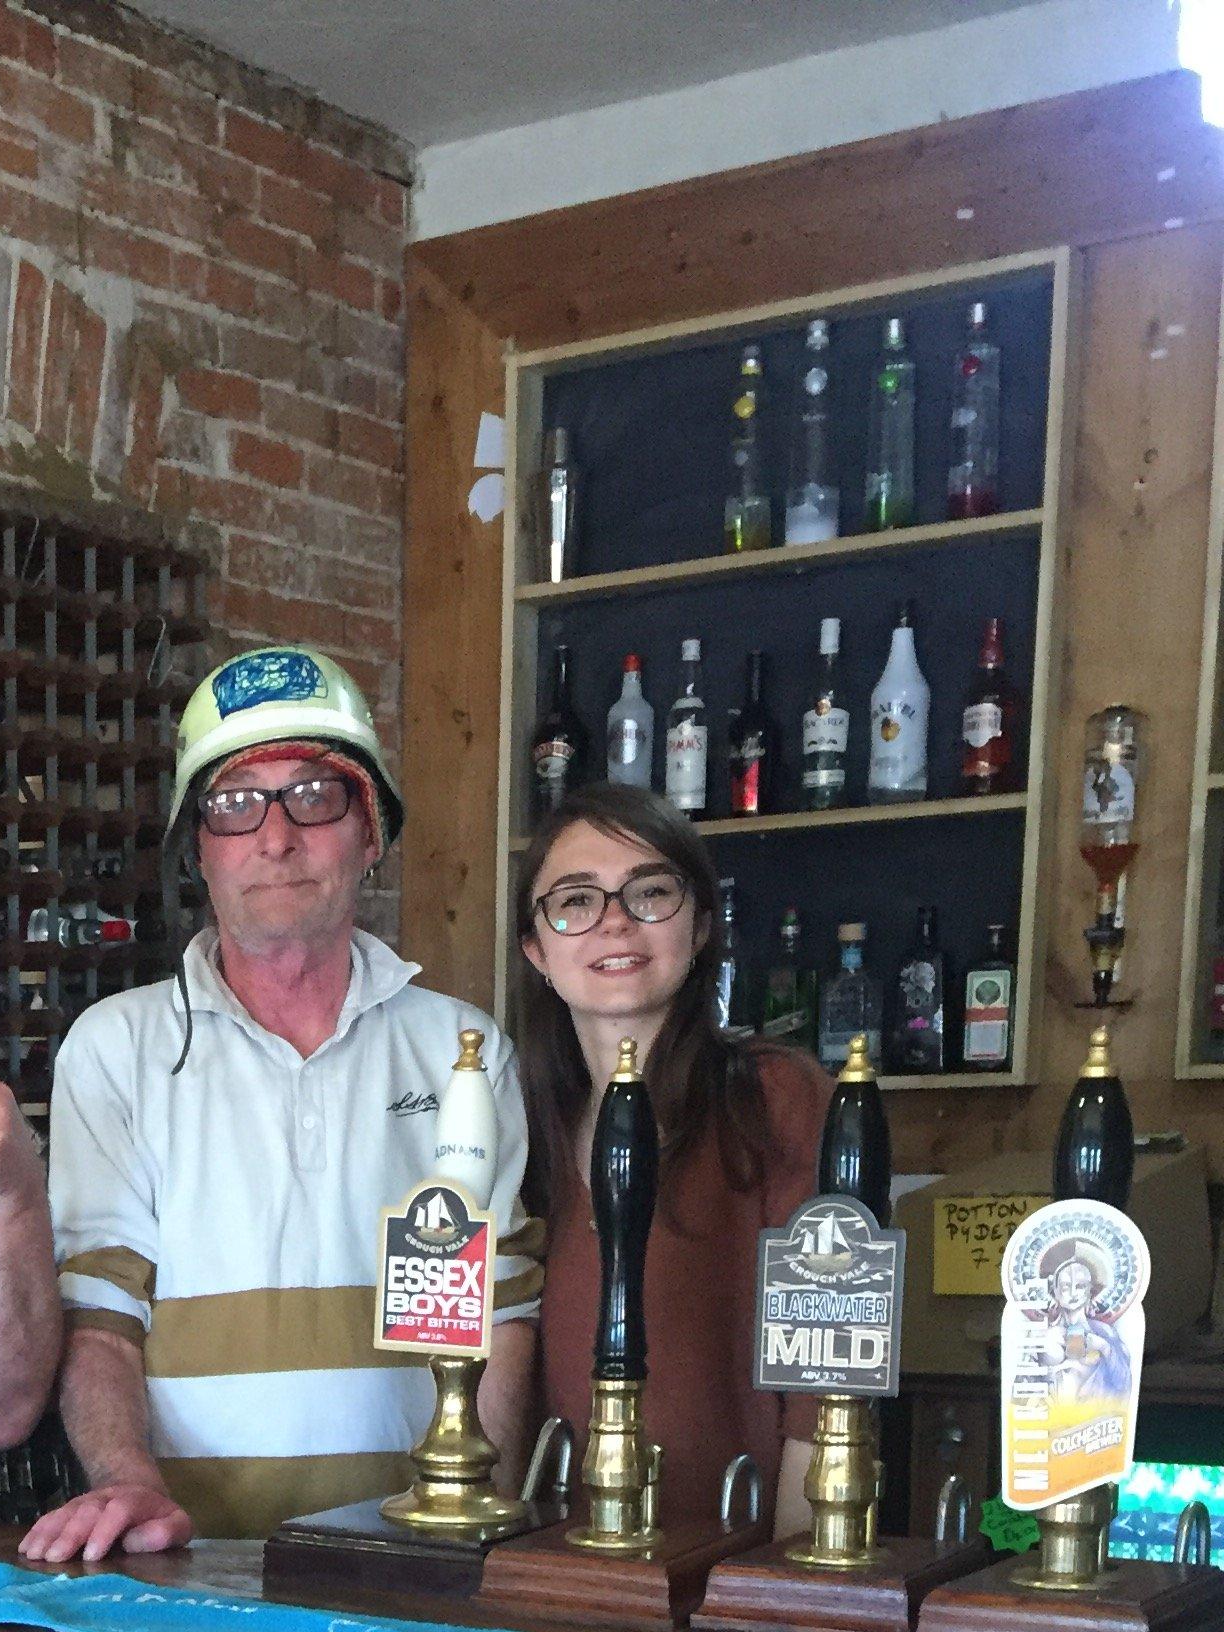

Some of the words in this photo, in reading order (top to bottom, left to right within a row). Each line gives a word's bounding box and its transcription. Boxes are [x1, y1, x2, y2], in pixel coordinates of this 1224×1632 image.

[943, 1200, 1027, 1222] POTTON
[388, 1255, 483, 1297] ESSEX
[789, 1261, 837, 1283] CROUCH
[386, 1292, 482, 1318] BOYS
[766, 1290, 888, 1323] BLACKWATER
[386, 1314, 424, 1326] BEST
[427, 1317, 480, 1331] BITTER
[767, 1326, 884, 1369] MILD
[1052, 1417, 1123, 1455] COLCHESTER
